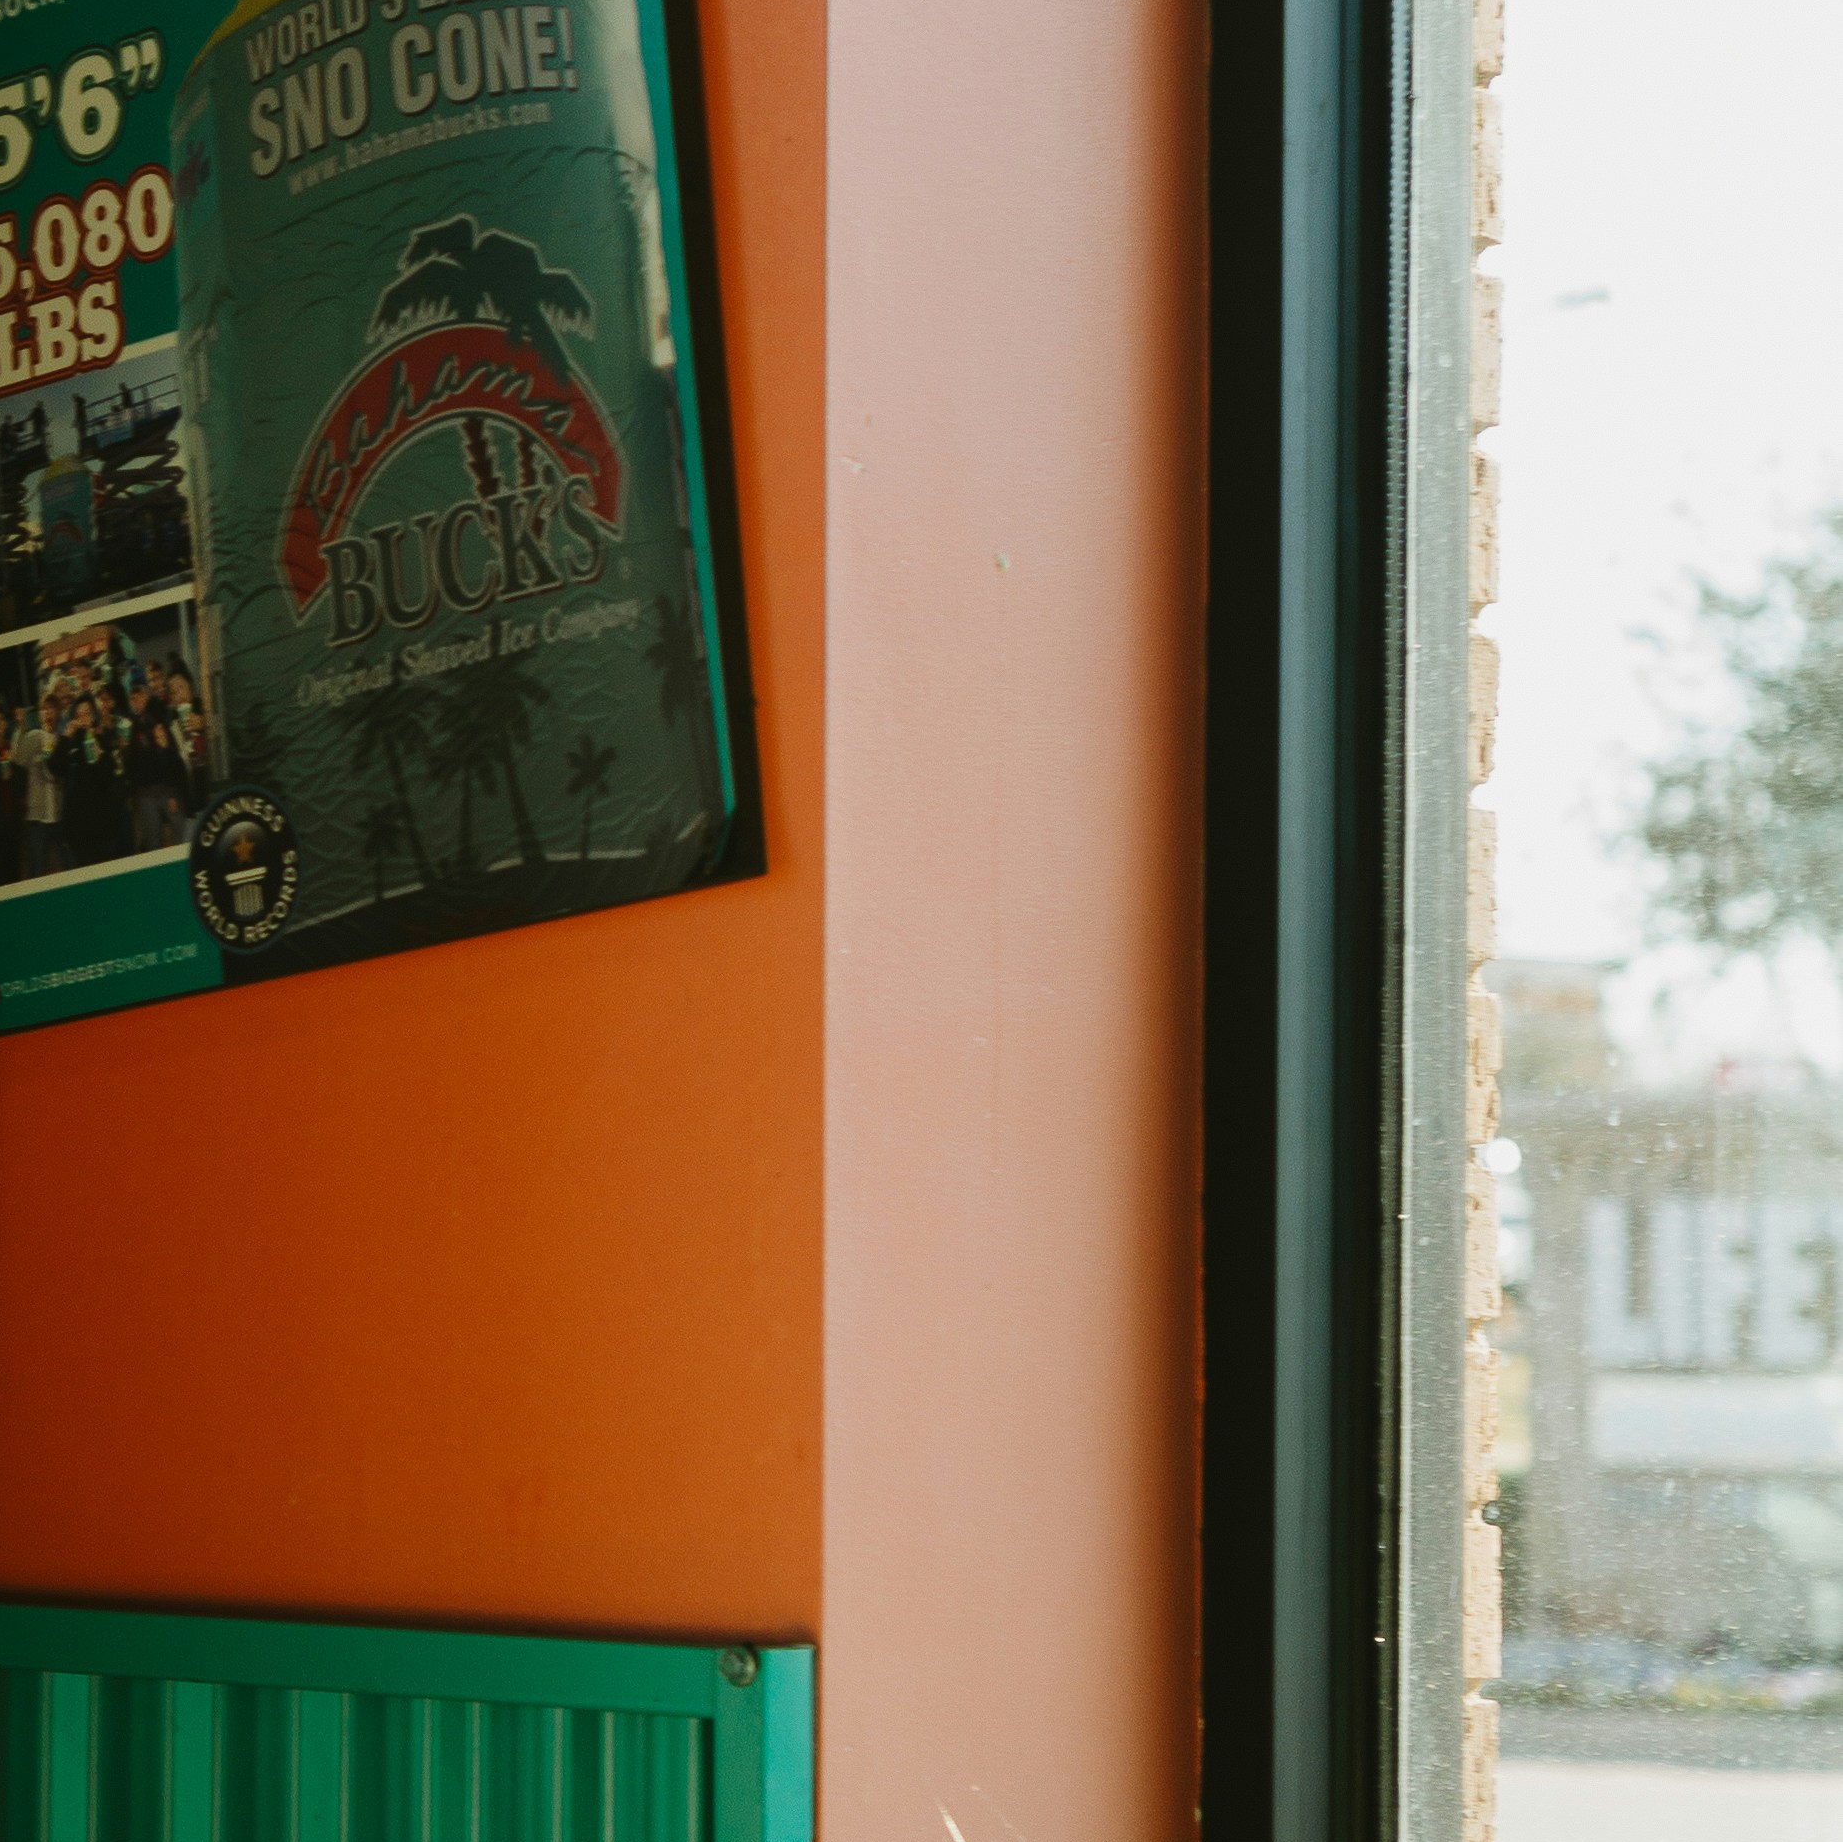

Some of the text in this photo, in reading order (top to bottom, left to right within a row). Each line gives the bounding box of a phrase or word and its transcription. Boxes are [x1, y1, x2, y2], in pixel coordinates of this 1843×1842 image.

[249, 4, 580, 179] SNO CONE!
[305, 355, 600, 533] Bahama
[322, 473, 604, 649] BUCK'S
[499, 617, 537, 654] Ice
[200, 796, 287, 848] GUINNESS
[194, 849, 298, 944] WORLD RECORDS
